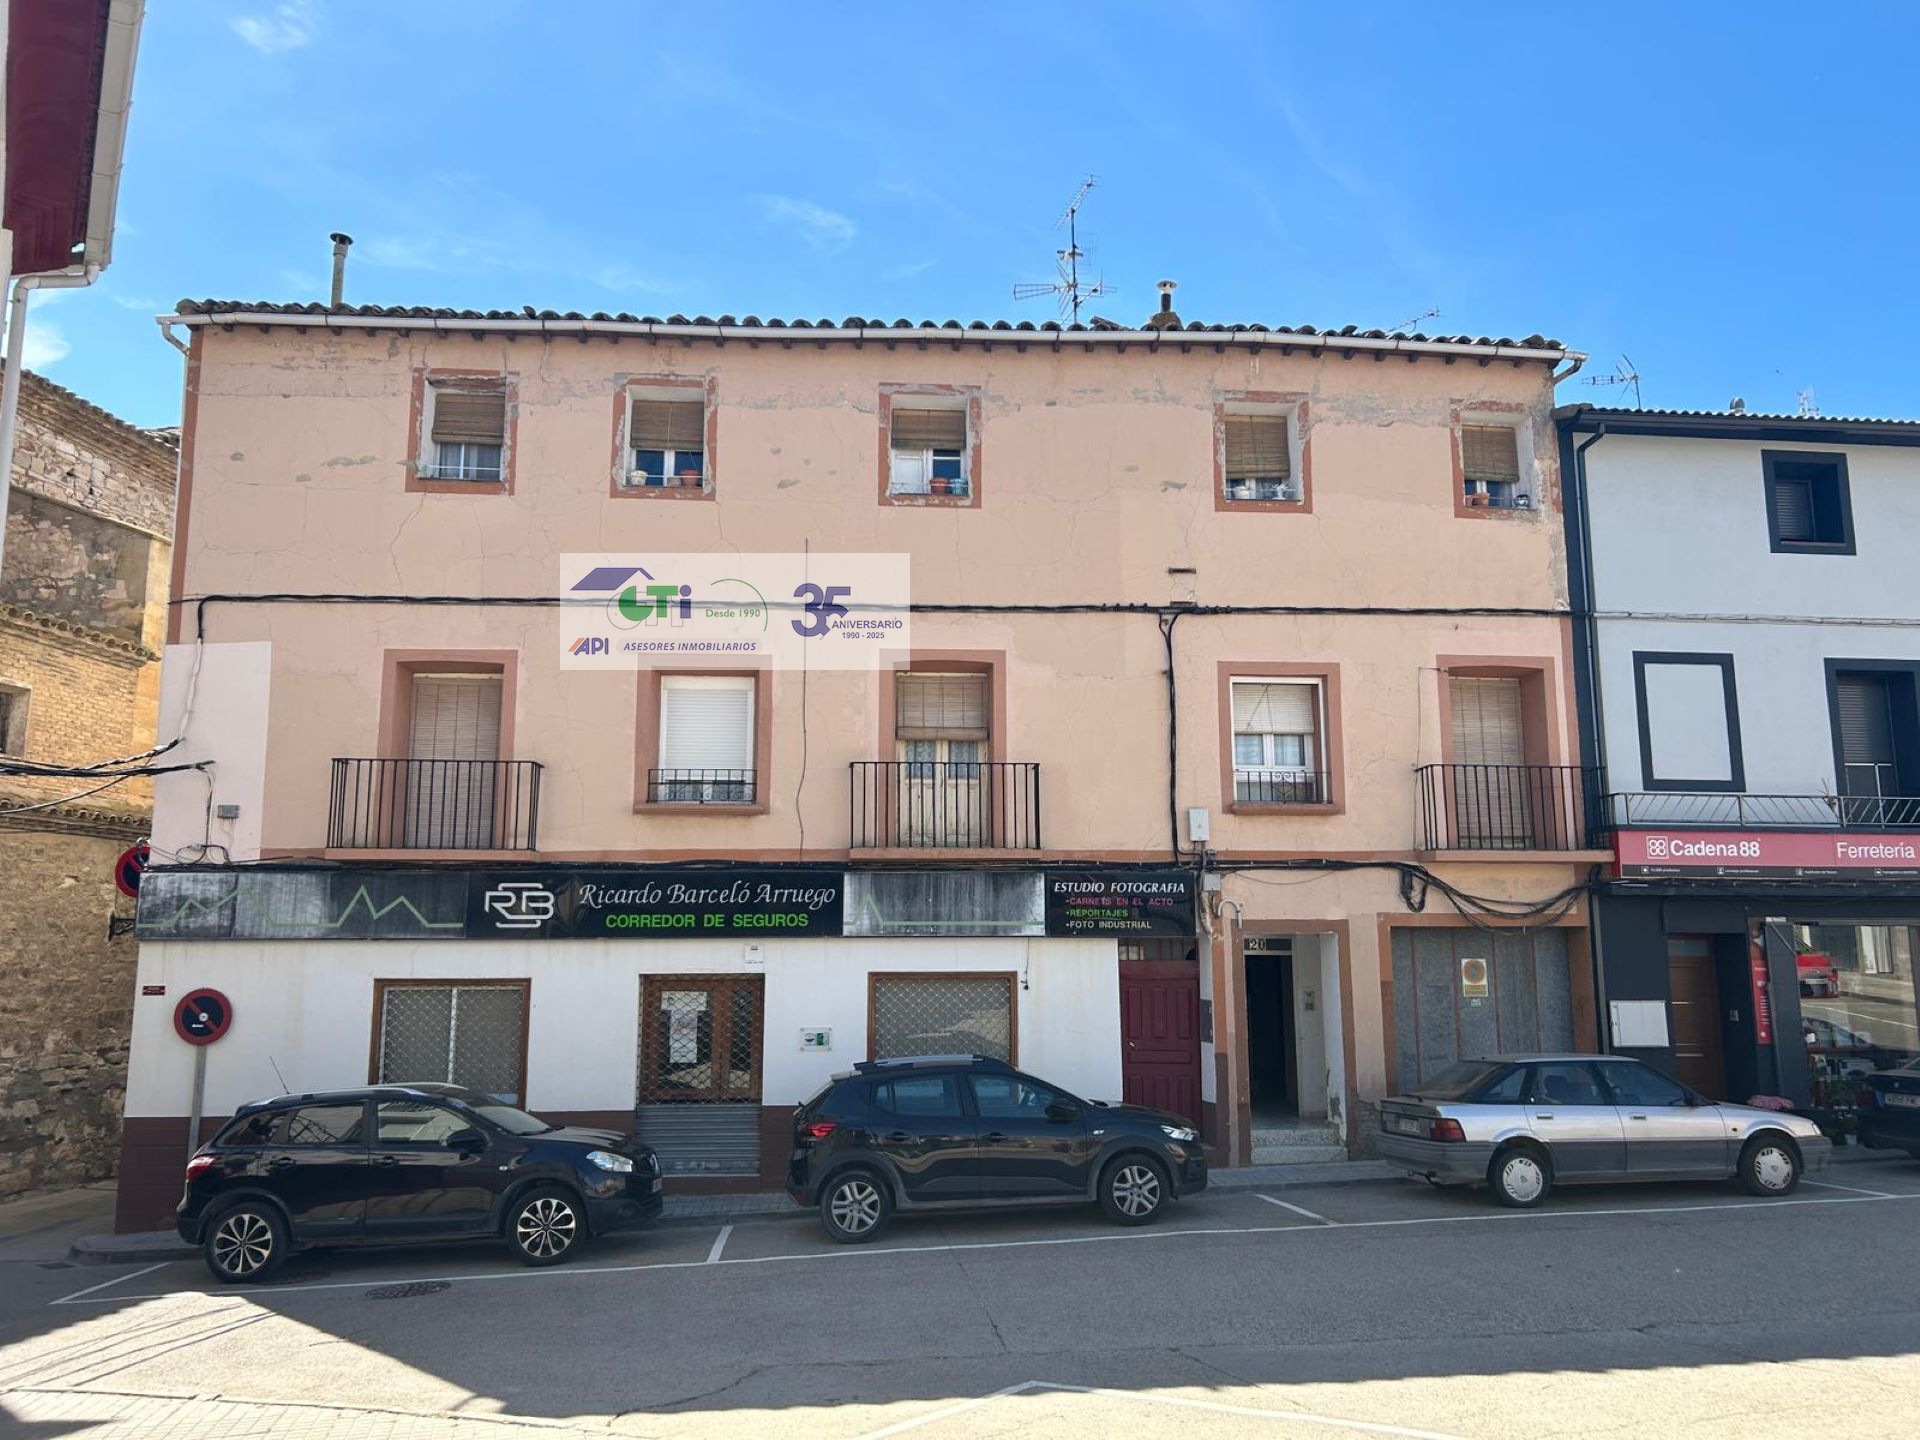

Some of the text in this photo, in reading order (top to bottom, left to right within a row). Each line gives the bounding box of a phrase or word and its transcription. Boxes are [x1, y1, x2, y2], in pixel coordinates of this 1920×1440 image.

[1054, 882, 1185, 894] ESTUDIO FOTOGRAFIA
[579, 880, 836, 910] Ricardo Barceló Arruego
[1116, 897, 1129, 906] EN
[1133, 897, 1144, 906] EL
[1149, 897, 1174, 906] ACTO
[1069, 909, 1129, 918] REPORTAJES
[606, 914, 809, 928] CORREDOR DE SEGUROS
[1069, 920, 1153, 929] FOTO INDUSTRIAL
[1250, 939, 1266, 950] 20
